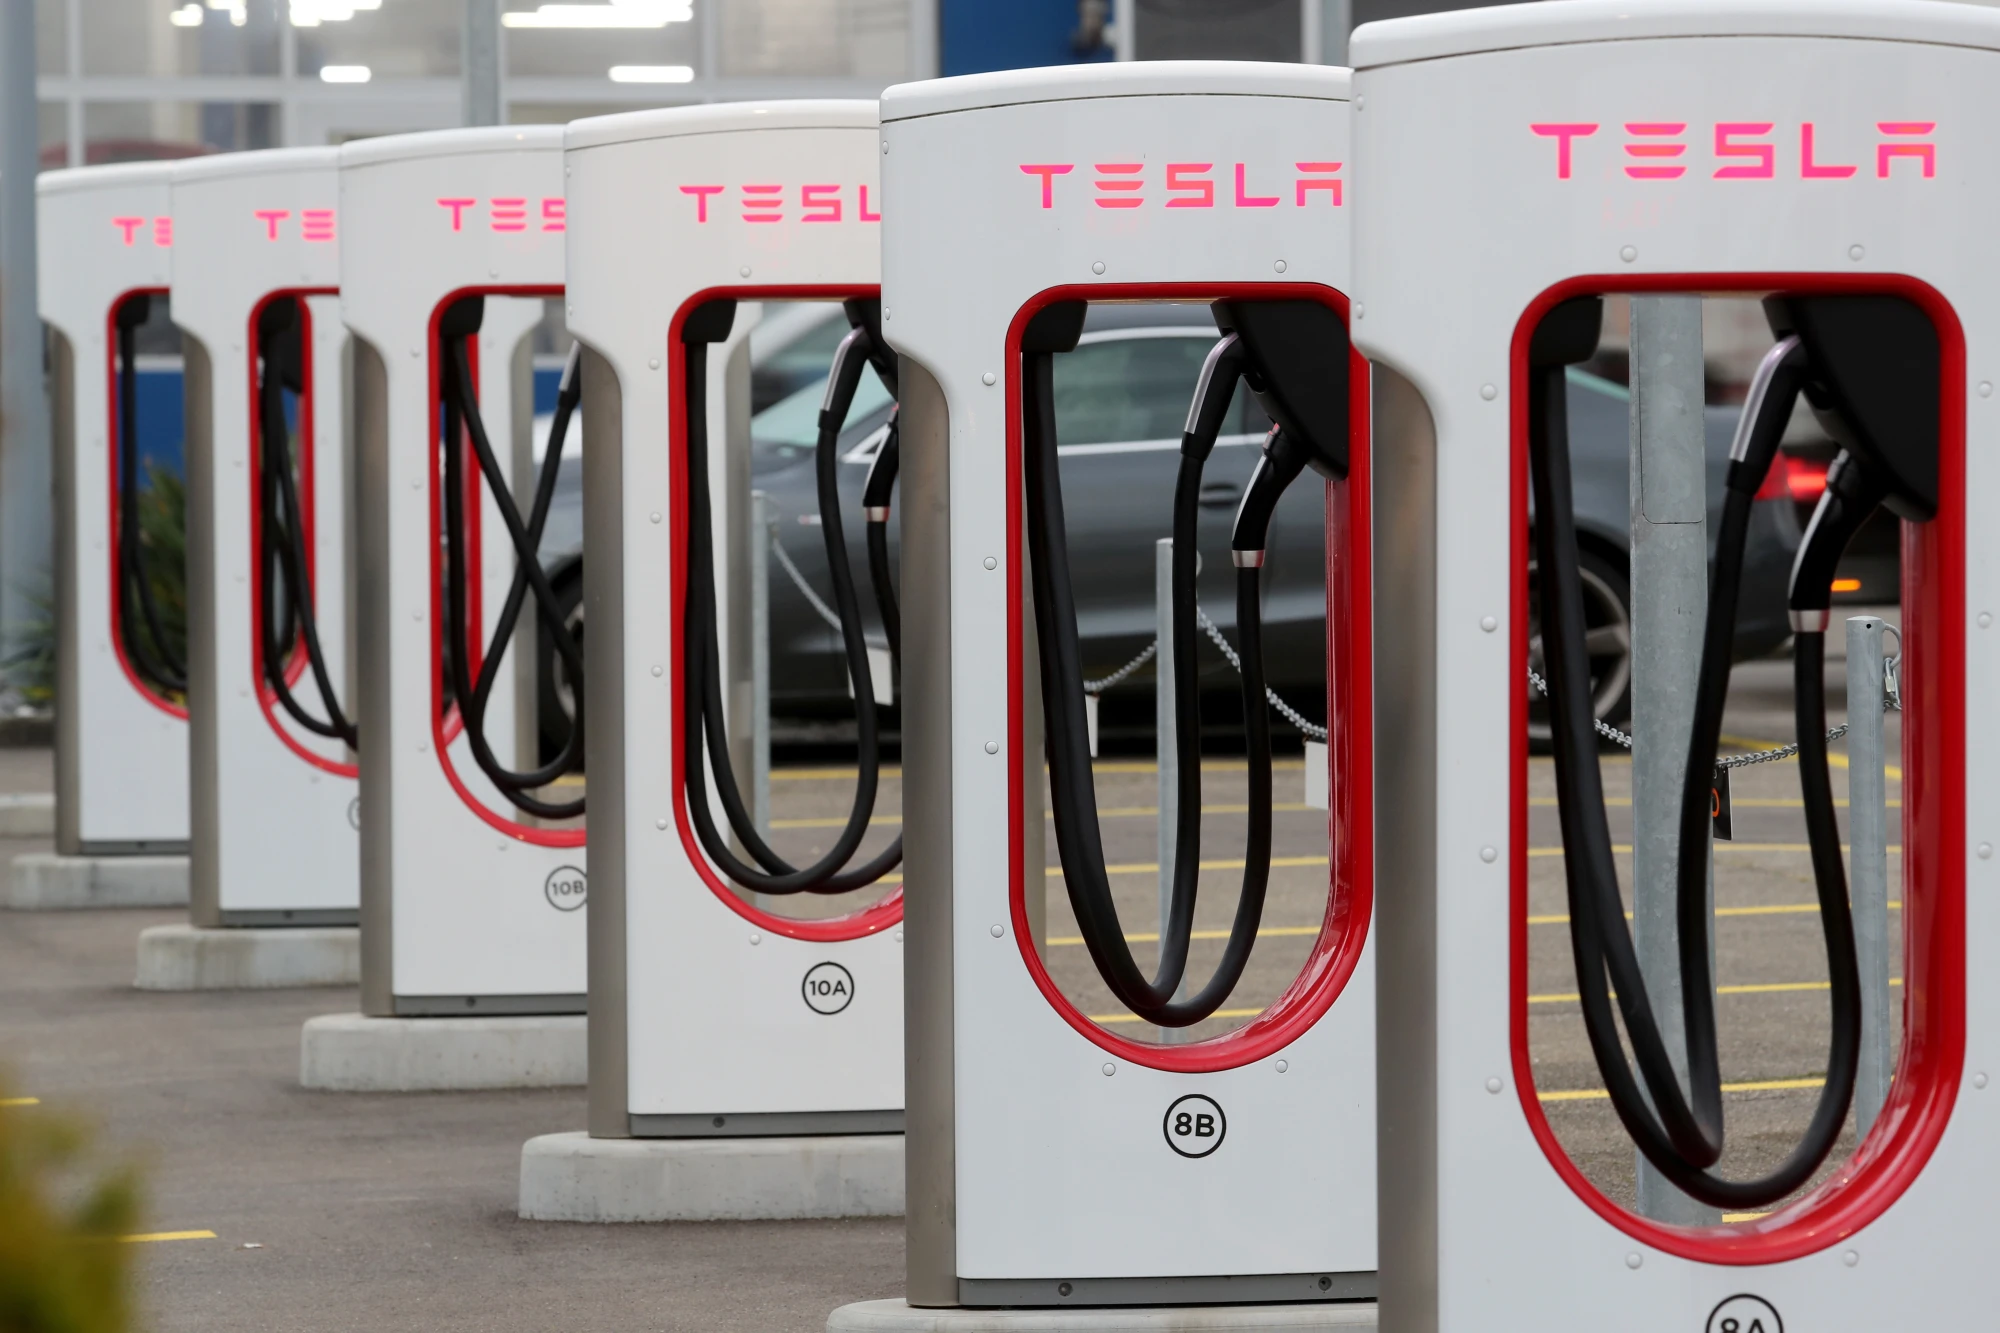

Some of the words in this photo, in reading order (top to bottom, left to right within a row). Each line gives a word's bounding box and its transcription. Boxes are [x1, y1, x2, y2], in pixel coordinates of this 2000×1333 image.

[1530, 122, 1937, 180] TESLA
[1019, 163, 1343, 208] TESLA
[551, 881, 583, 896] 10B
[809, 980, 847, 996] 10A
[1174, 1112, 1215, 1137] 8B
